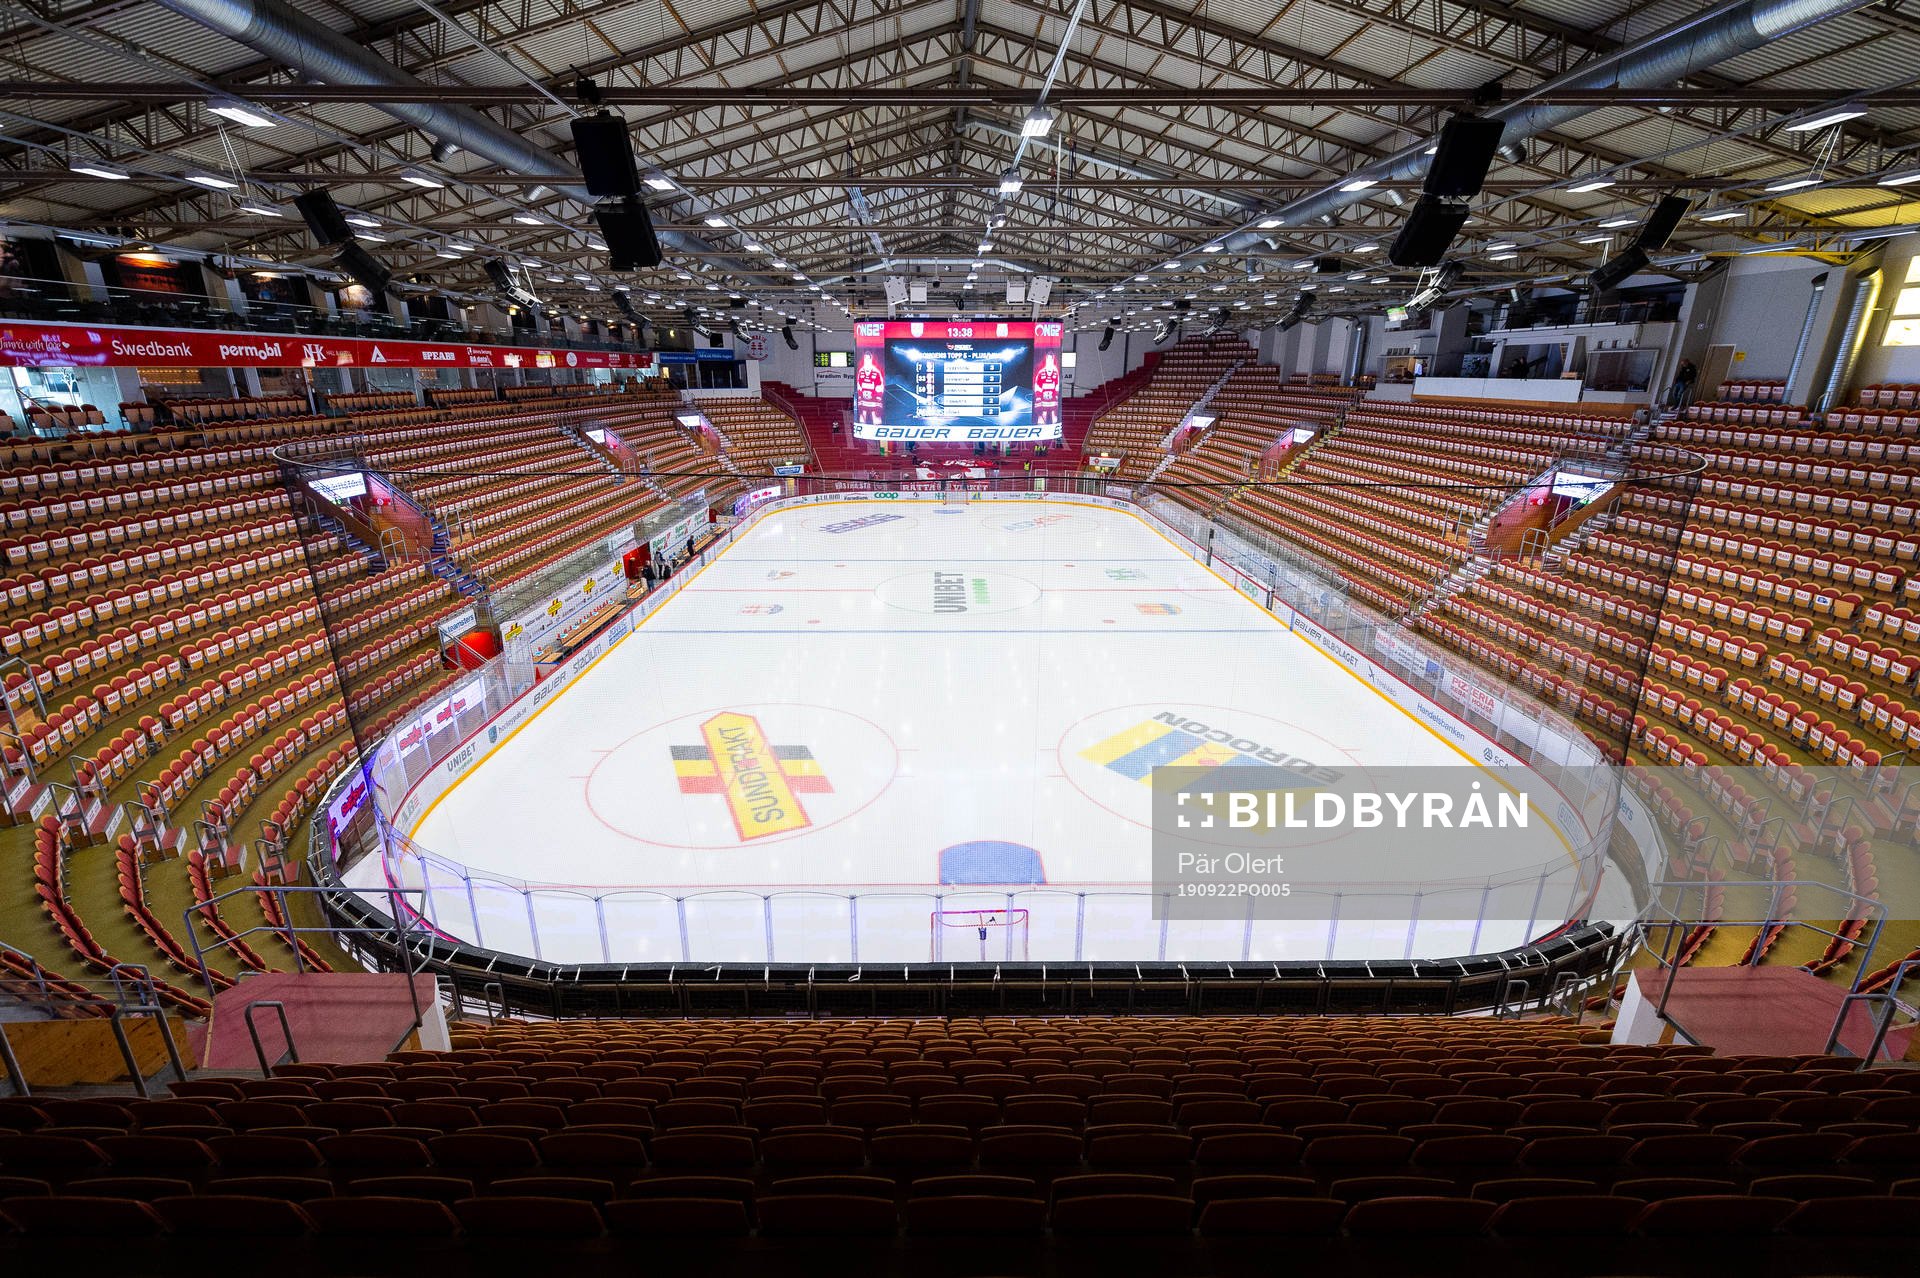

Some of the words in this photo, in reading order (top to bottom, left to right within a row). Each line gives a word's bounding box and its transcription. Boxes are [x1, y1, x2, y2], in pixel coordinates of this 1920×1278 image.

[111, 340, 193, 357] Swedbank
[947, 327, 973, 338] 13:38
[219, 343, 281, 361] permobil
[874, 492, 899, 500] coop
[934, 571, 968, 613] UNIBET
[1322, 635, 1359, 668] BILBOLAGET
[1451, 676, 1495, 709] PIZERIA
[1416, 702, 1466, 742] Handelsbanken
[446, 741, 478, 773] UNIBET
[1152, 711, 1346, 785] EUROCON
[1493, 755, 1510, 772] SCA
